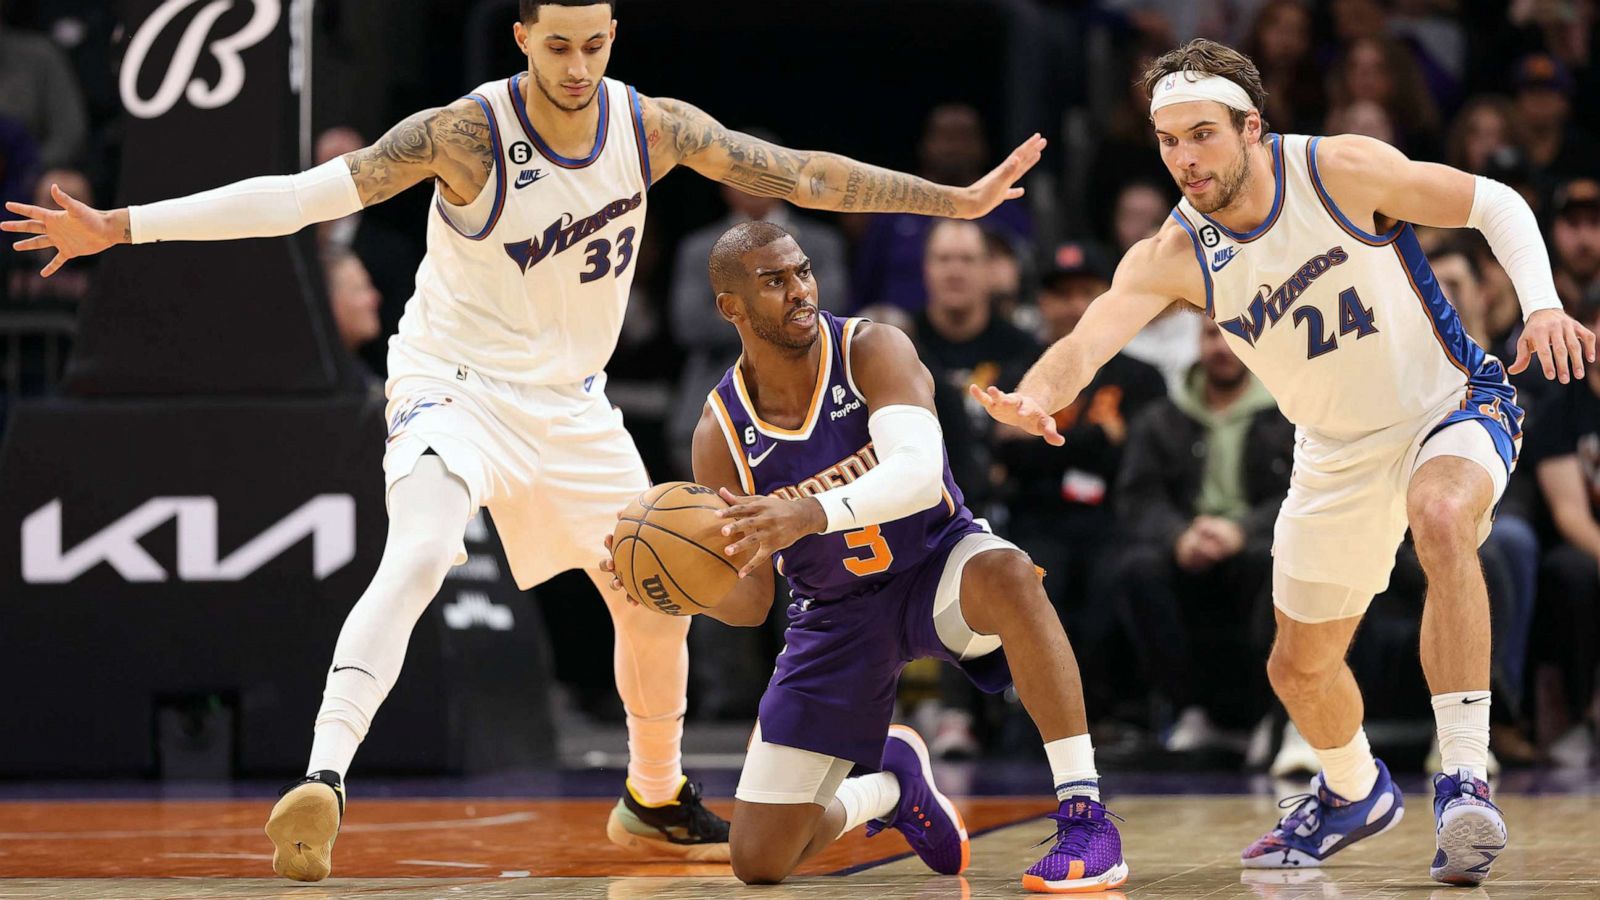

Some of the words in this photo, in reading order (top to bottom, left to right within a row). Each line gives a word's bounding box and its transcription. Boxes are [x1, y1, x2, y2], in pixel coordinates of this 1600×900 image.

[513, 143, 528, 163] 6
[519, 169, 541, 181] NIKE
[1201, 225, 1219, 248] 6
[580, 226, 636, 284] 33
[1214, 245, 1234, 264] NIKE
[1218, 246, 1349, 349] WIZARDS
[1292, 286, 1379, 360] 24
[830, 399, 861, 421] PayPal
[744, 425, 757, 445] 6
[772, 441, 880, 501] HOENI
[843, 524, 894, 577] 3
